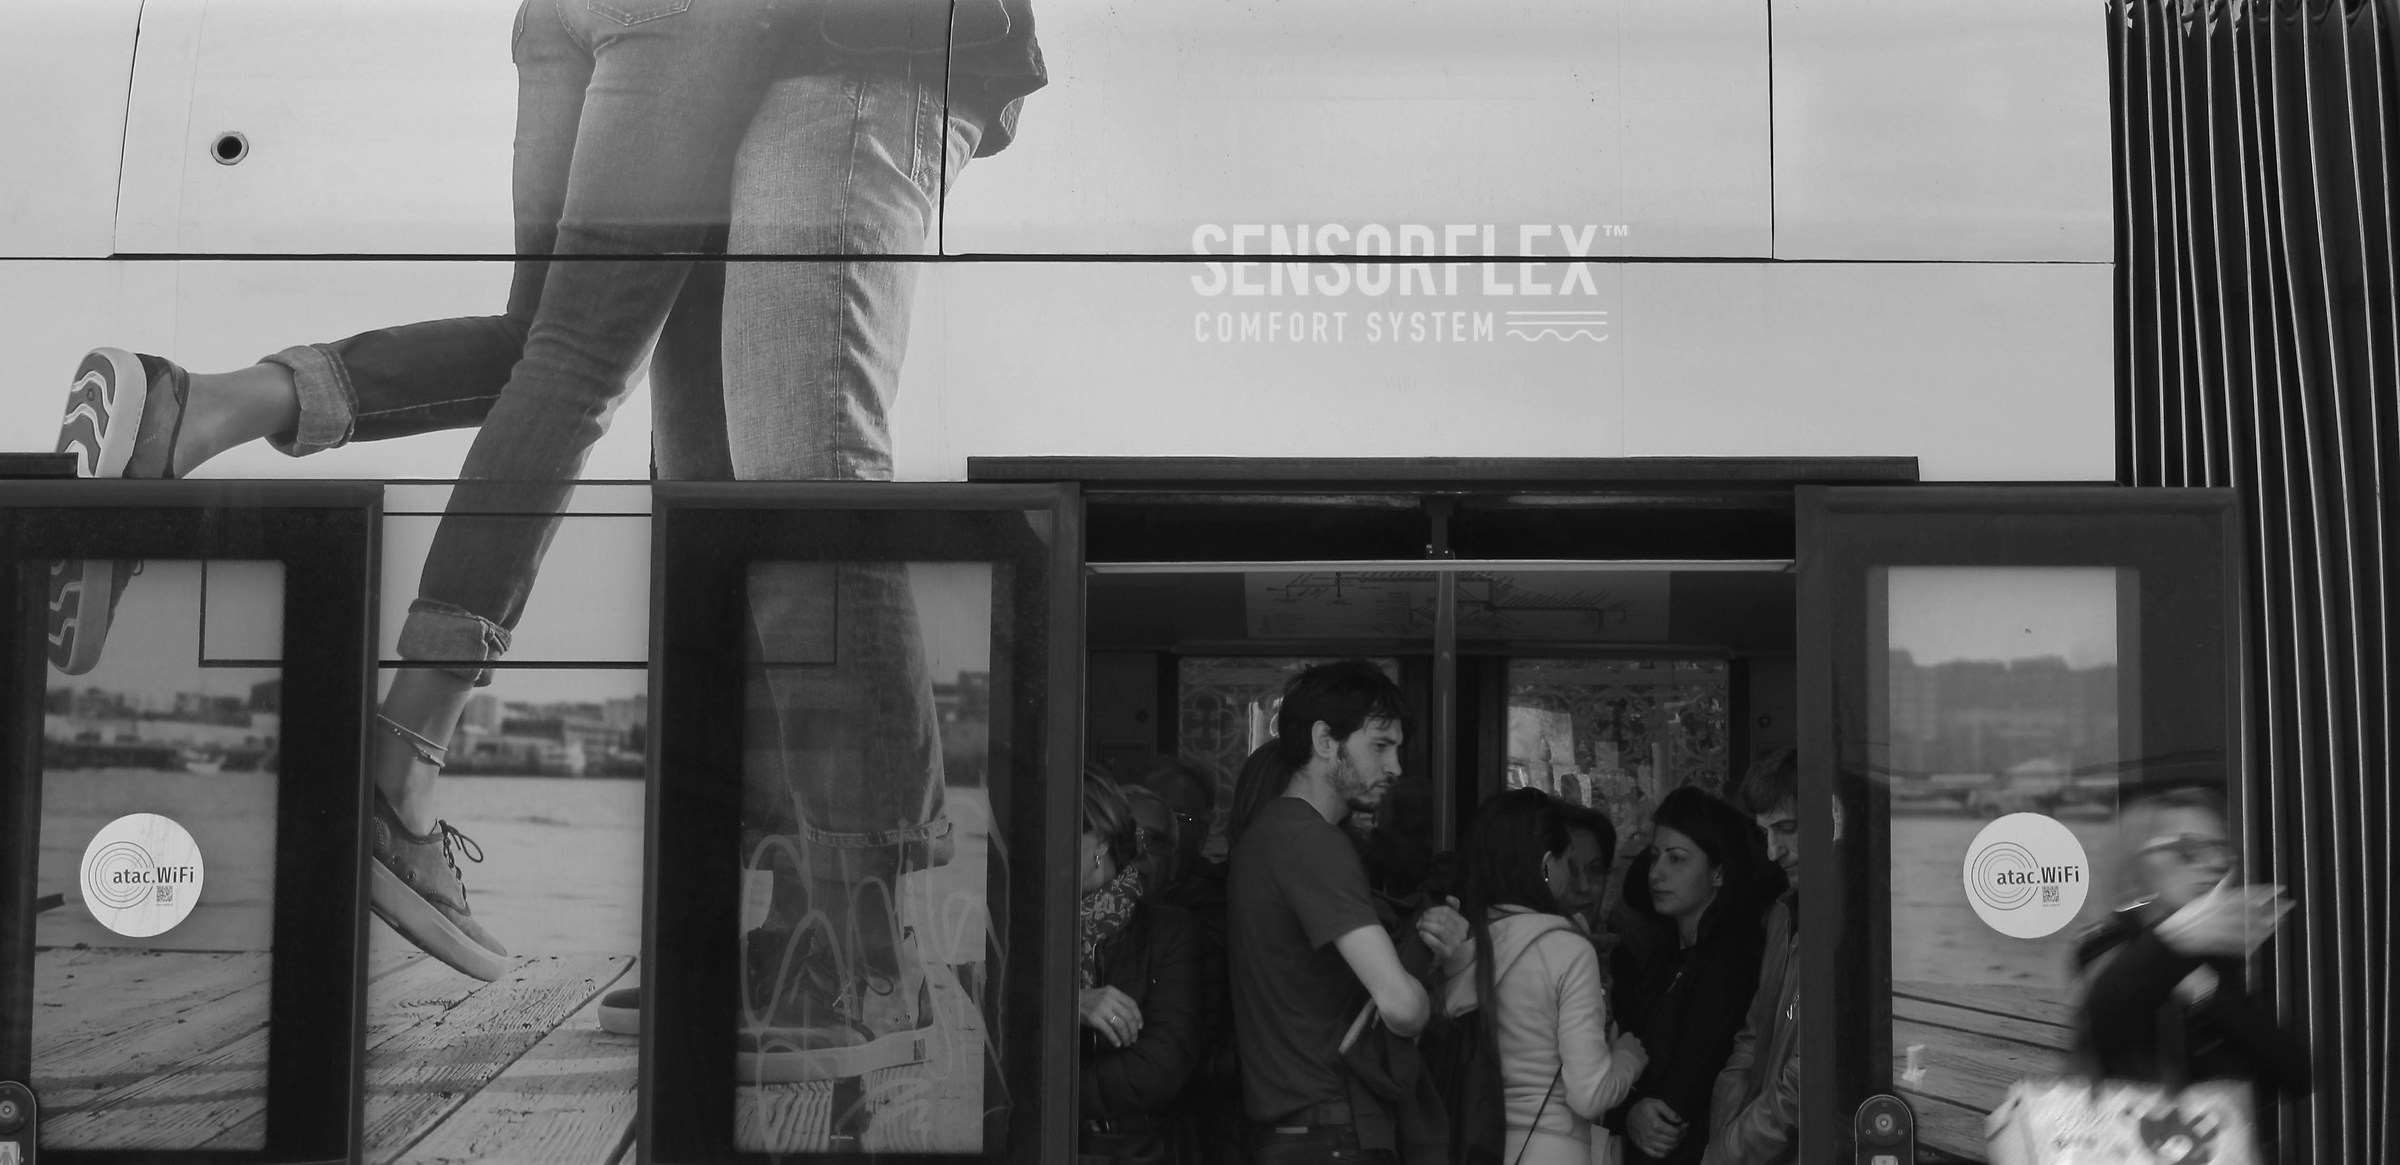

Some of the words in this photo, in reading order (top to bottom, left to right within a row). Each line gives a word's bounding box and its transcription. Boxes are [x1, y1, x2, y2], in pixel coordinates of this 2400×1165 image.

[1195, 312, 1348, 342] COMFORT
[1366, 312, 1494, 342] SYSTEM
[113, 866, 194, 884] atac.WiFi
[1997, 865, 2080, 885] atac.WiFi
